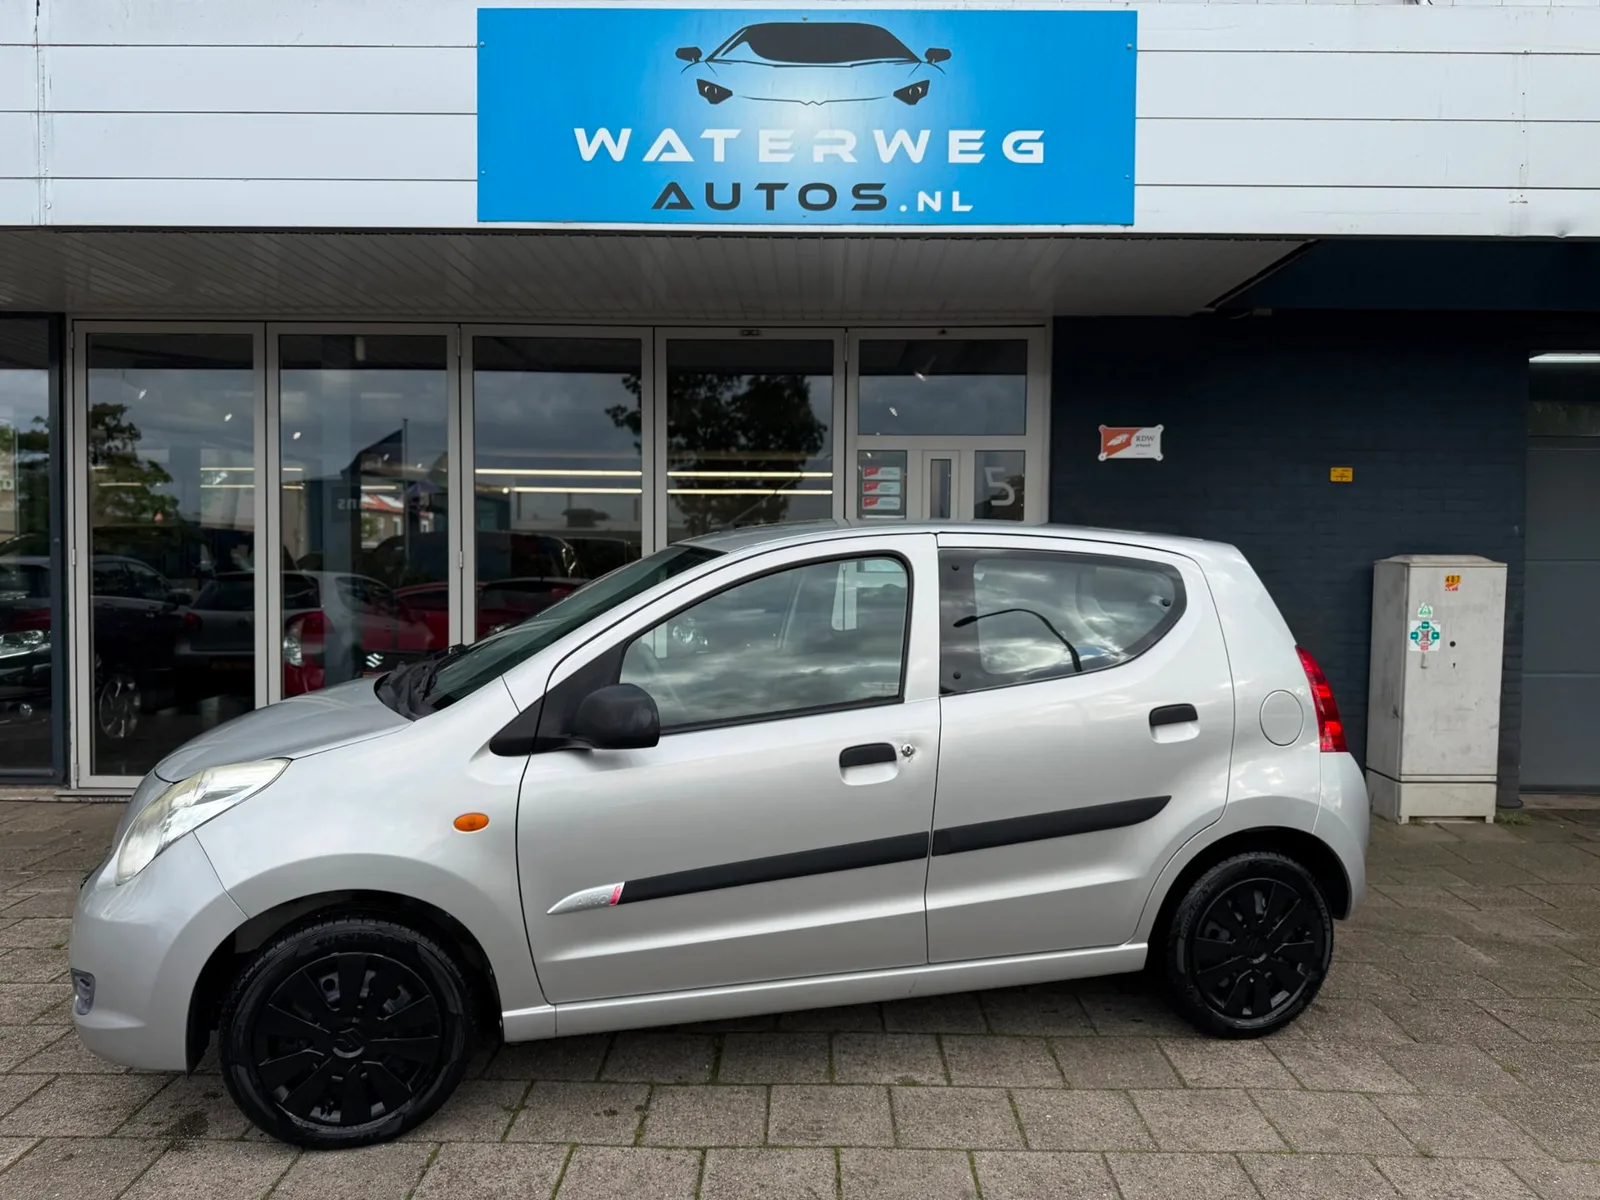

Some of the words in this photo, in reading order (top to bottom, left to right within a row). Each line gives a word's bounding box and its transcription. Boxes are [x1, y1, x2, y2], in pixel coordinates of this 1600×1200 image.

[573, 128, 1045, 163] WATERWEG
[651, 181, 973, 211] AUTOS.NL
[984, 466, 1016, 506] 5
